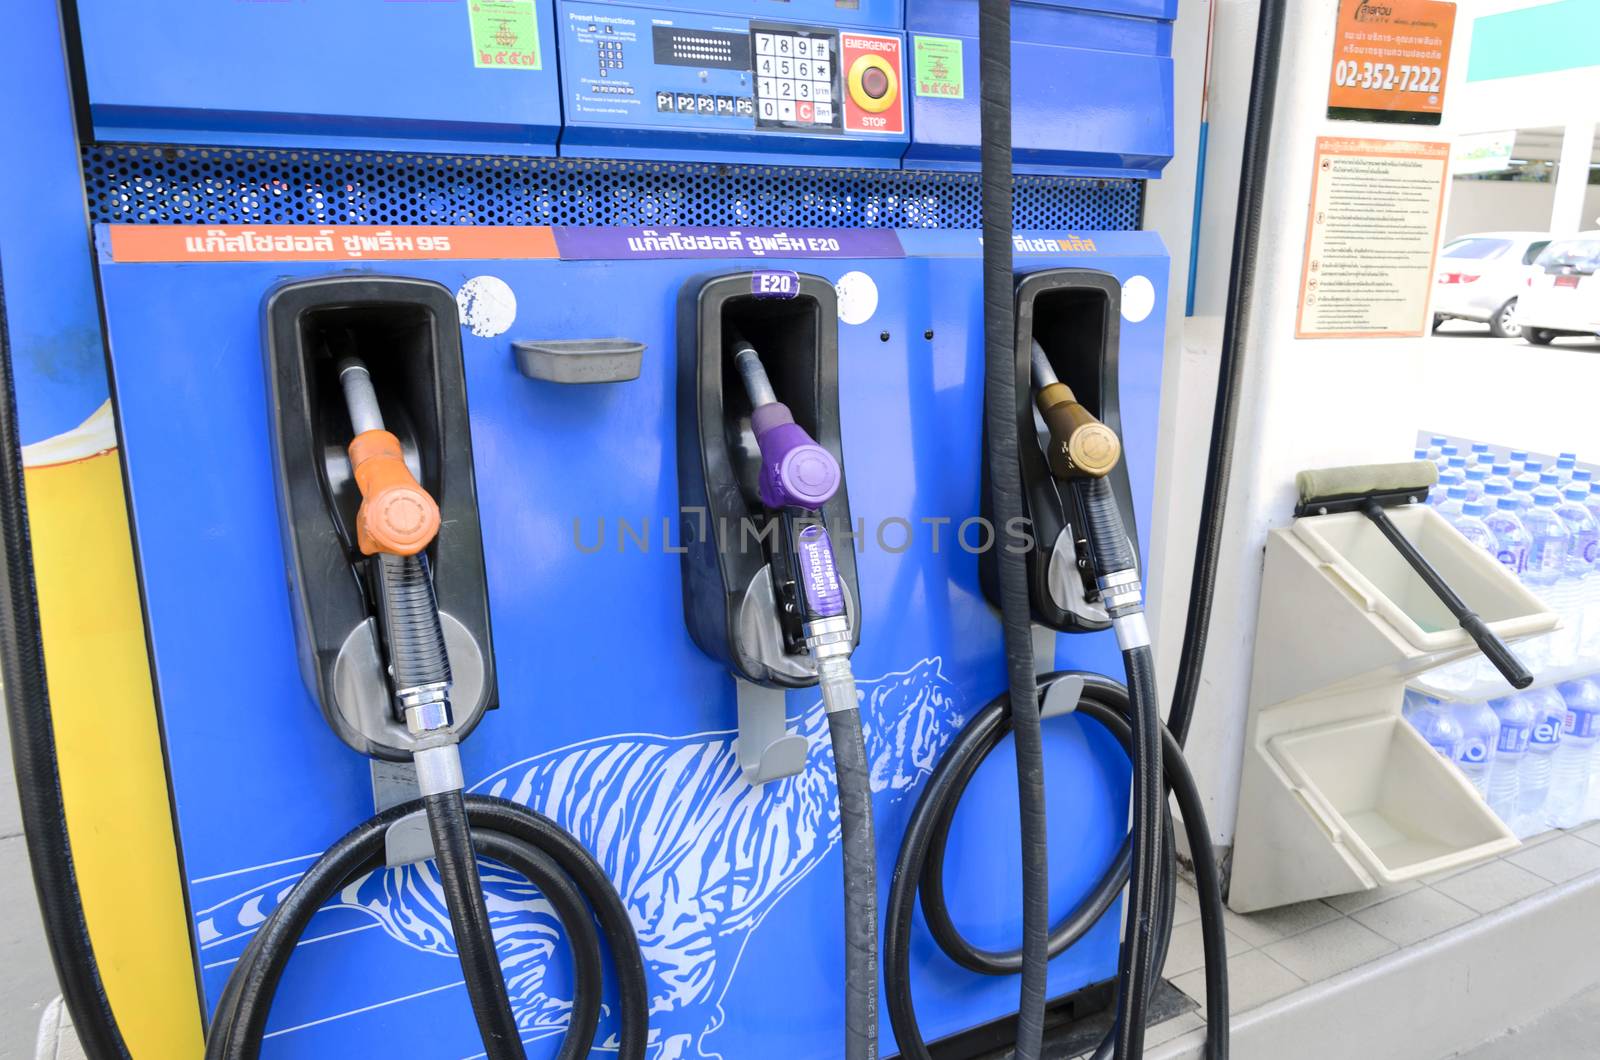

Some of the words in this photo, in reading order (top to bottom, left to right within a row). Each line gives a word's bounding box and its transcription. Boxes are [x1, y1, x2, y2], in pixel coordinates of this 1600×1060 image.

[761, 38, 770, 51] 7
[780, 39, 788, 53] 8
[798, 41, 807, 55] 9
[845, 39, 897, 52] EMERGENCY
[762, 59, 771, 73] 4
[781, 60, 790, 74] 5
[799, 62, 808, 76] 6
[1335, 59, 1441, 93] 02-352-7222
[764, 81, 770, 95] 1
[782, 83, 791, 96] 2
[800, 84, 809, 98] 3
[657, 95, 673, 109] P1
[677, 96, 695, 110] P2
[697, 98, 714, 111] P3
[717, 99, 734, 112] P4
[736, 100, 753, 113] P5
[764, 102, 773, 116] 0
[799, 104, 811, 119] C
[862, 116, 887, 127] STOP
[416, 236, 451, 251] 95
[807, 238, 840, 251] E20
[760, 274, 791, 293] E20
